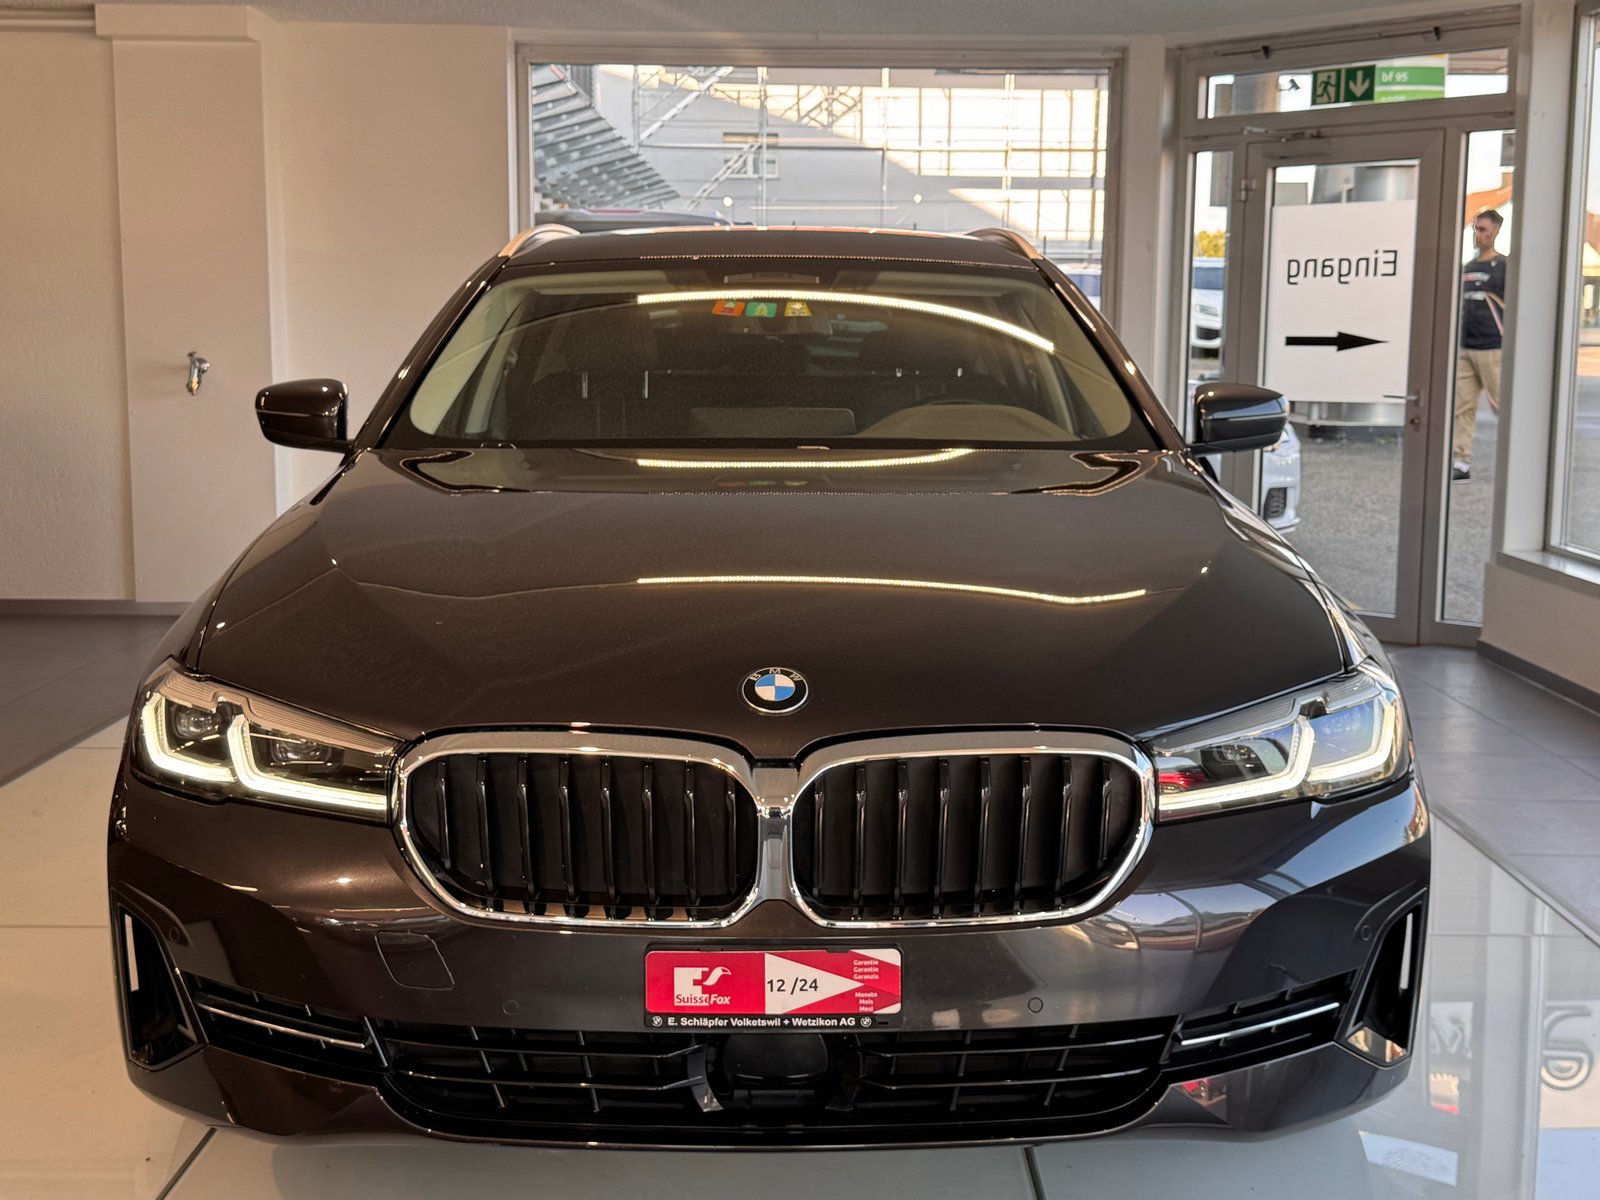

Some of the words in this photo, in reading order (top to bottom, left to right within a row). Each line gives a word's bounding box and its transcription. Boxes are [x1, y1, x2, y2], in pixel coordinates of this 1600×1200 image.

[749, 667, 802, 681] BMW
[675, 994, 731, 1005] SuisseFox
[667, 1017, 678, 1026] E.
[680, 1017, 728, 1028] Schläpfer
[730, 1017, 780, 1027] Volketswil
[791, 1017, 838, 1027] Wetzikon
[839, 1017, 856, 1027] AG
